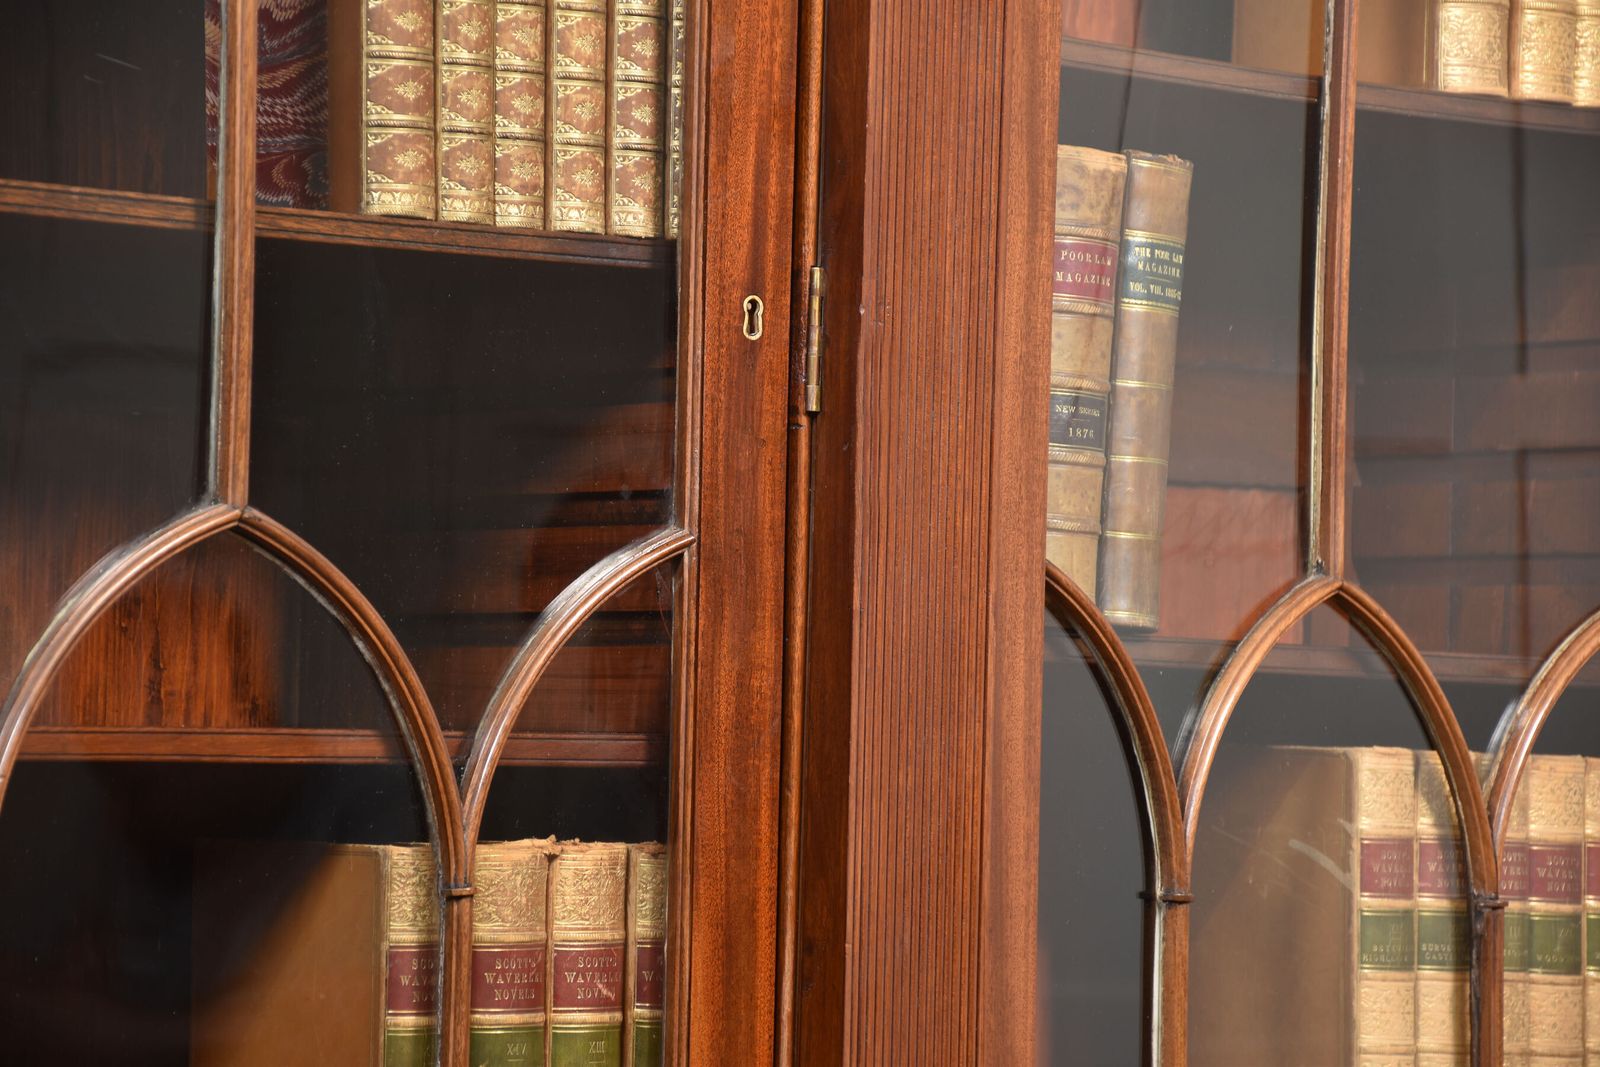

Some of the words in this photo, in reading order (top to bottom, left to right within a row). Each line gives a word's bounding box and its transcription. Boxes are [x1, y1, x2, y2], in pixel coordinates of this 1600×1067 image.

[1060, 249, 1092, 263] POOR
[1095, 254, 1112, 266] LAW
[1135, 246, 1151, 258] THE
[1137, 261, 1180, 277] MAGAZINE
[1056, 271, 1111, 287] MAGAZINE
[1055, 404, 1076, 413] NEW
[494, 957, 537, 970] SCOTT'S
[577, 955, 618, 968] SCOTT'S
[494, 987, 536, 1001] NOVELS
